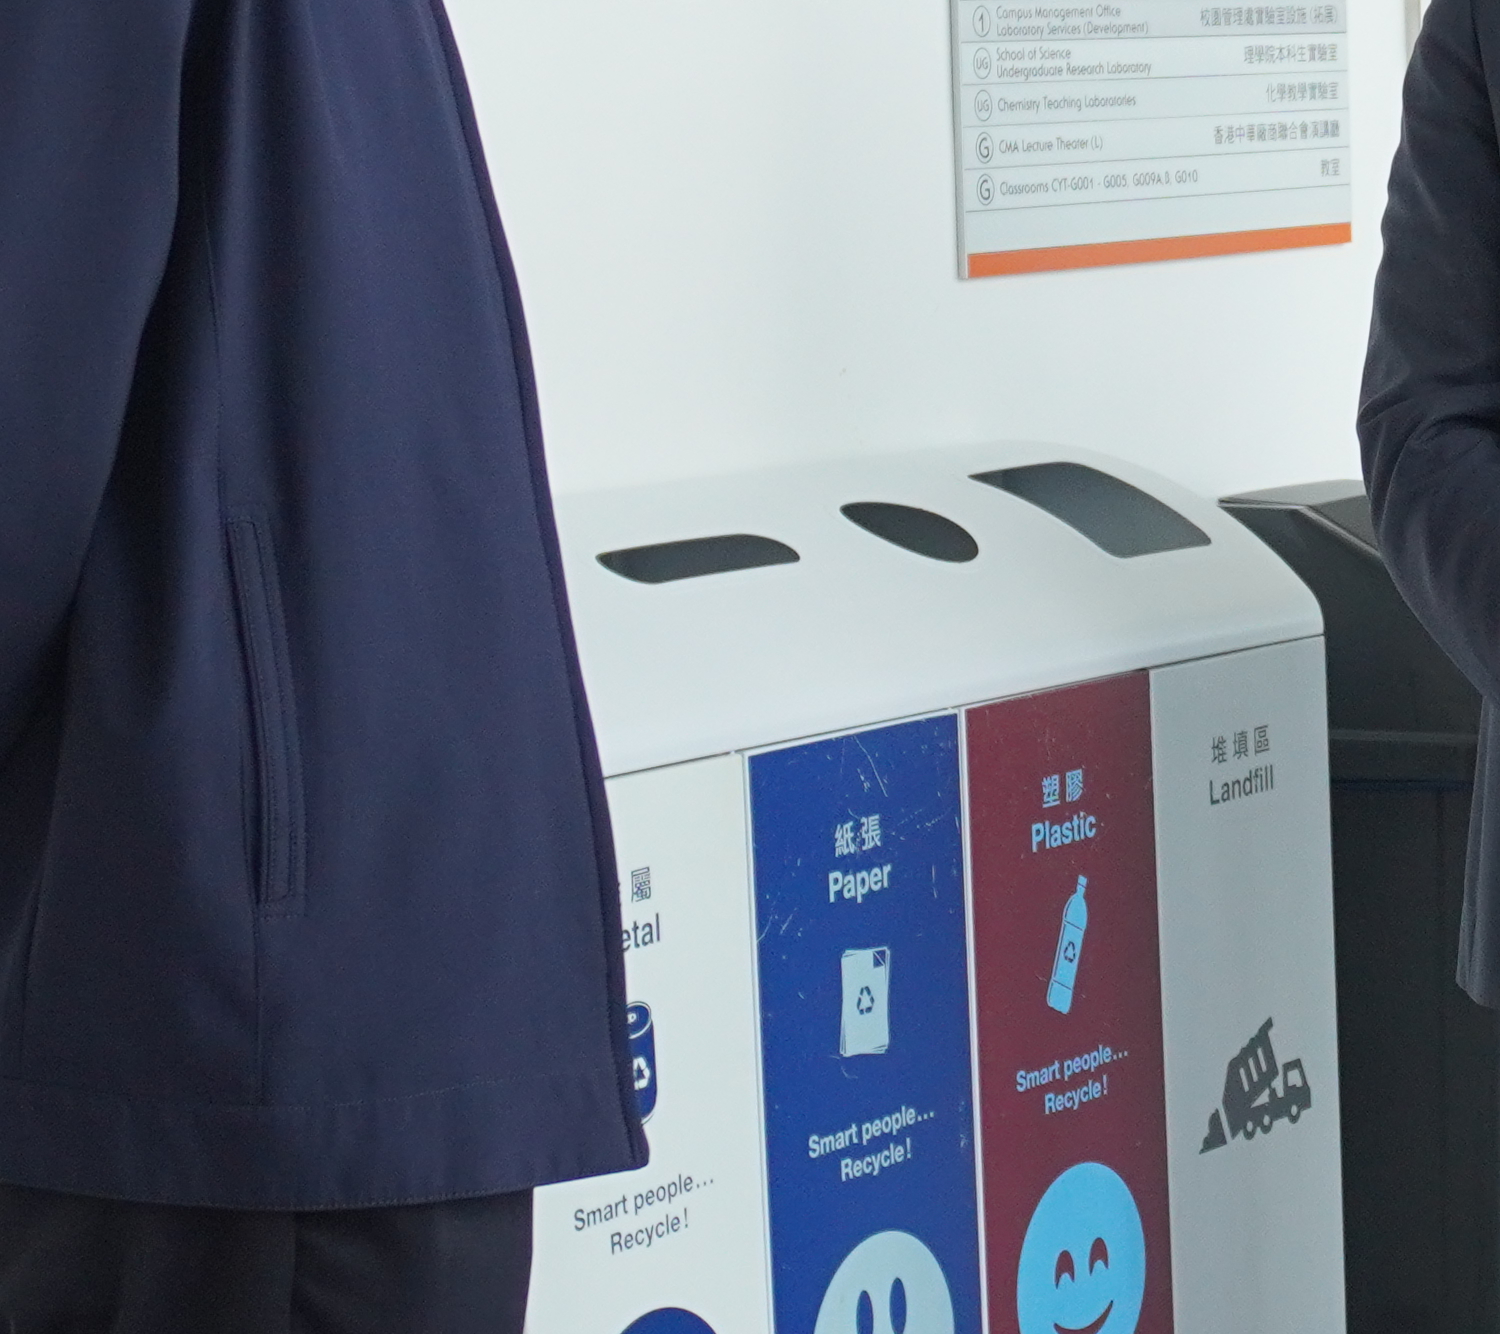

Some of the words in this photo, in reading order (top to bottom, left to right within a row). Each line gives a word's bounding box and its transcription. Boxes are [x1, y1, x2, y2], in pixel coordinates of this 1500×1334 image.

[995, 5, 1033, 22] Campus
[1034, 6, 1093, 22] Management
[1095, 3, 1121, 18] Office
[996, 23, 1046, 41] Laboratory
[1046, 21, 1081, 35] Services
[1083, 20, 1148, 37] (Development)
[995, 47, 1025, 62] School
[1027, 47, 1037, 61] of
[1038, 45, 1072, 60] Science
[996, 64, 1064, 82] Undergraduate
[1065, 61, 1104, 76] Research
[1106, 61, 1152, 76] Laboratory
[997, 97, 1040, 114] Chemistry
[1042, 95, 1082, 112] Teaching
[1084, 94, 1136, 108] Laboratories
[998, 139, 1019, 154] CMA
[1021, 139, 1054, 153] Lecture
[1055, 136, 1089, 150] Theater
[999, 181, 1049, 196] Classrooms
[1050, 176, 1093, 192] CYT-G001
[1174, 169, 1198, 184] G010
[1320, 158, 1340, 177] 教室
[1211, 724, 1270, 764] 堆填區
[1041, 768, 1084, 808] 塑膠
[1209, 764, 1274, 805] Landfill
[834, 813, 882, 858] 紙張
[1031, 810, 1097, 853] Plastic
[828, 863, 892, 903] Paper
[620, 912, 661, 952] etal
[1016, 1060, 1061, 1092] Smart
[1044, 1074, 1108, 1115] Recycle!
[808, 1123, 859, 1158] Smart
[840, 1137, 911, 1182] Recycle!
[574, 1194, 628, 1231] Smart
[610, 1207, 689, 1255] Recycle!
